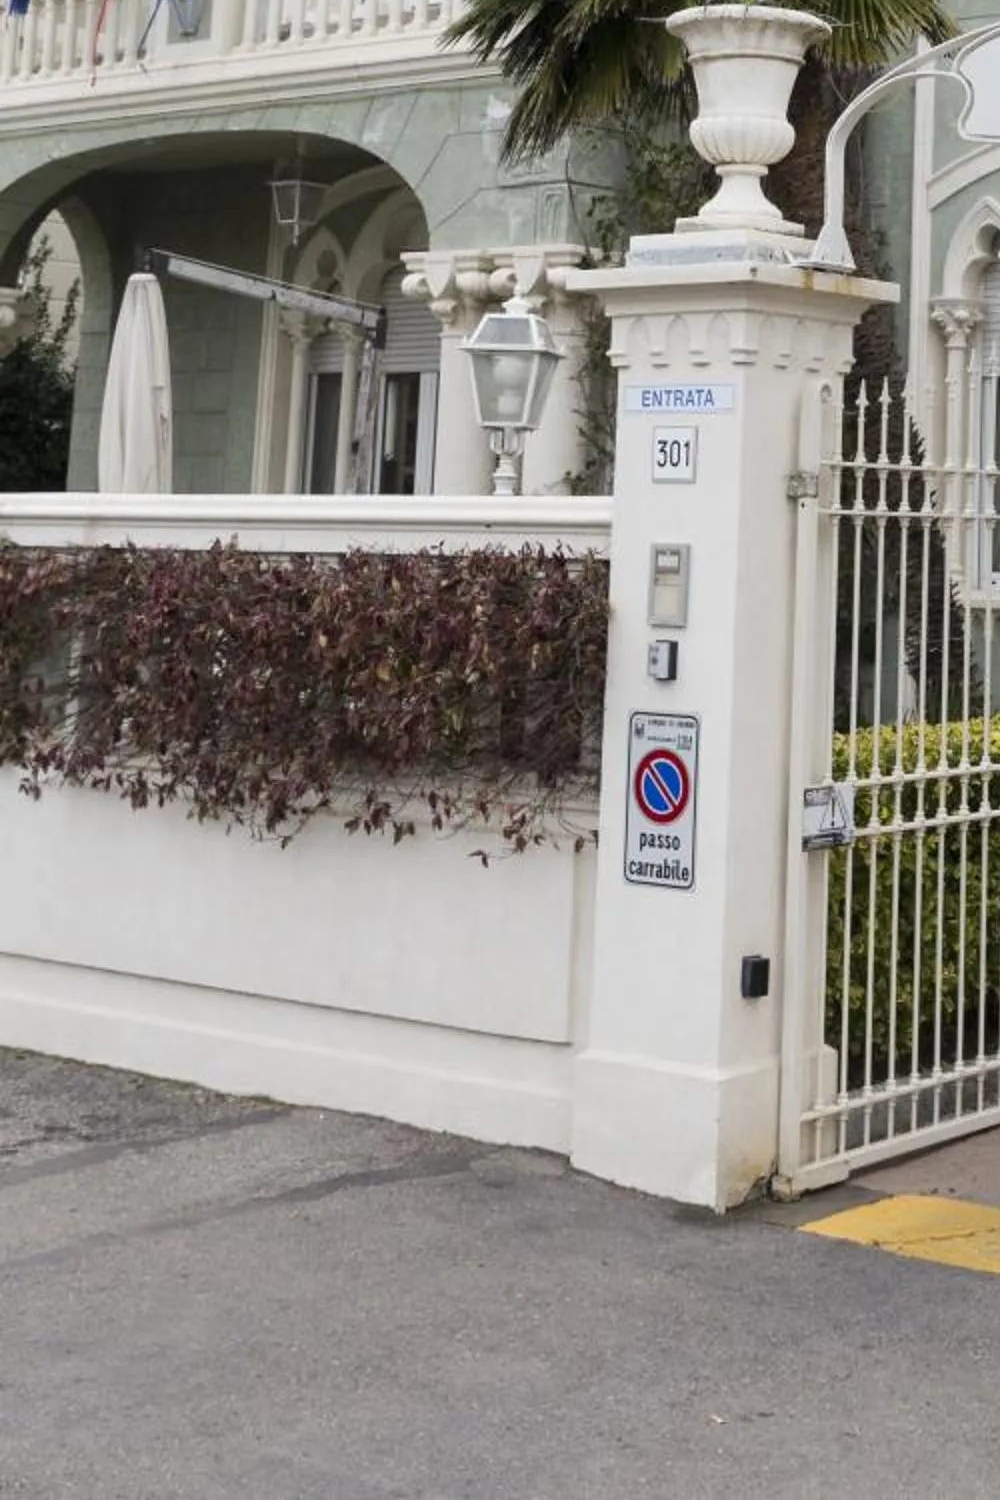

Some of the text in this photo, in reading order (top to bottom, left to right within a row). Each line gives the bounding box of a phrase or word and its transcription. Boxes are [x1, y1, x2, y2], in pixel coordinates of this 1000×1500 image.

[641, 388, 715, 408] ENTRATA
[656, 439, 691, 469] 301
[639, 831, 682, 851] passo
[628, 858, 690, 882] carrabile
